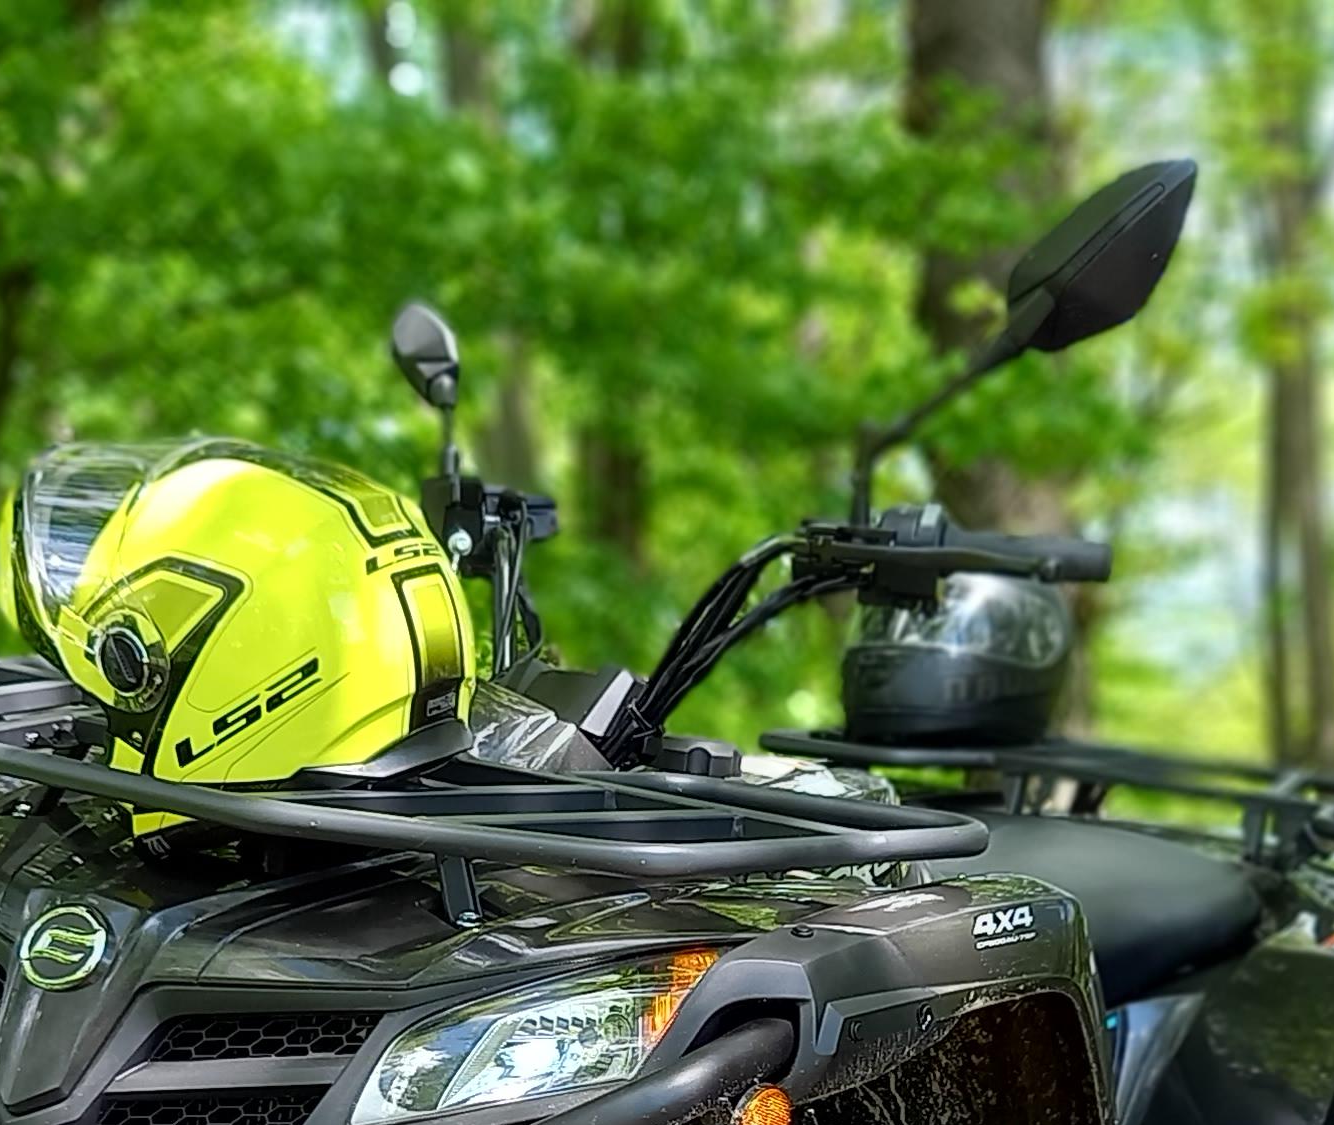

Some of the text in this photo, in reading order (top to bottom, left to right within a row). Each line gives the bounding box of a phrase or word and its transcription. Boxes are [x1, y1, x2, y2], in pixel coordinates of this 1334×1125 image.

[366, 542, 442, 576] LS2
[175, 657, 323, 769] LS2
[972, 905, 1034, 936] 4X4
